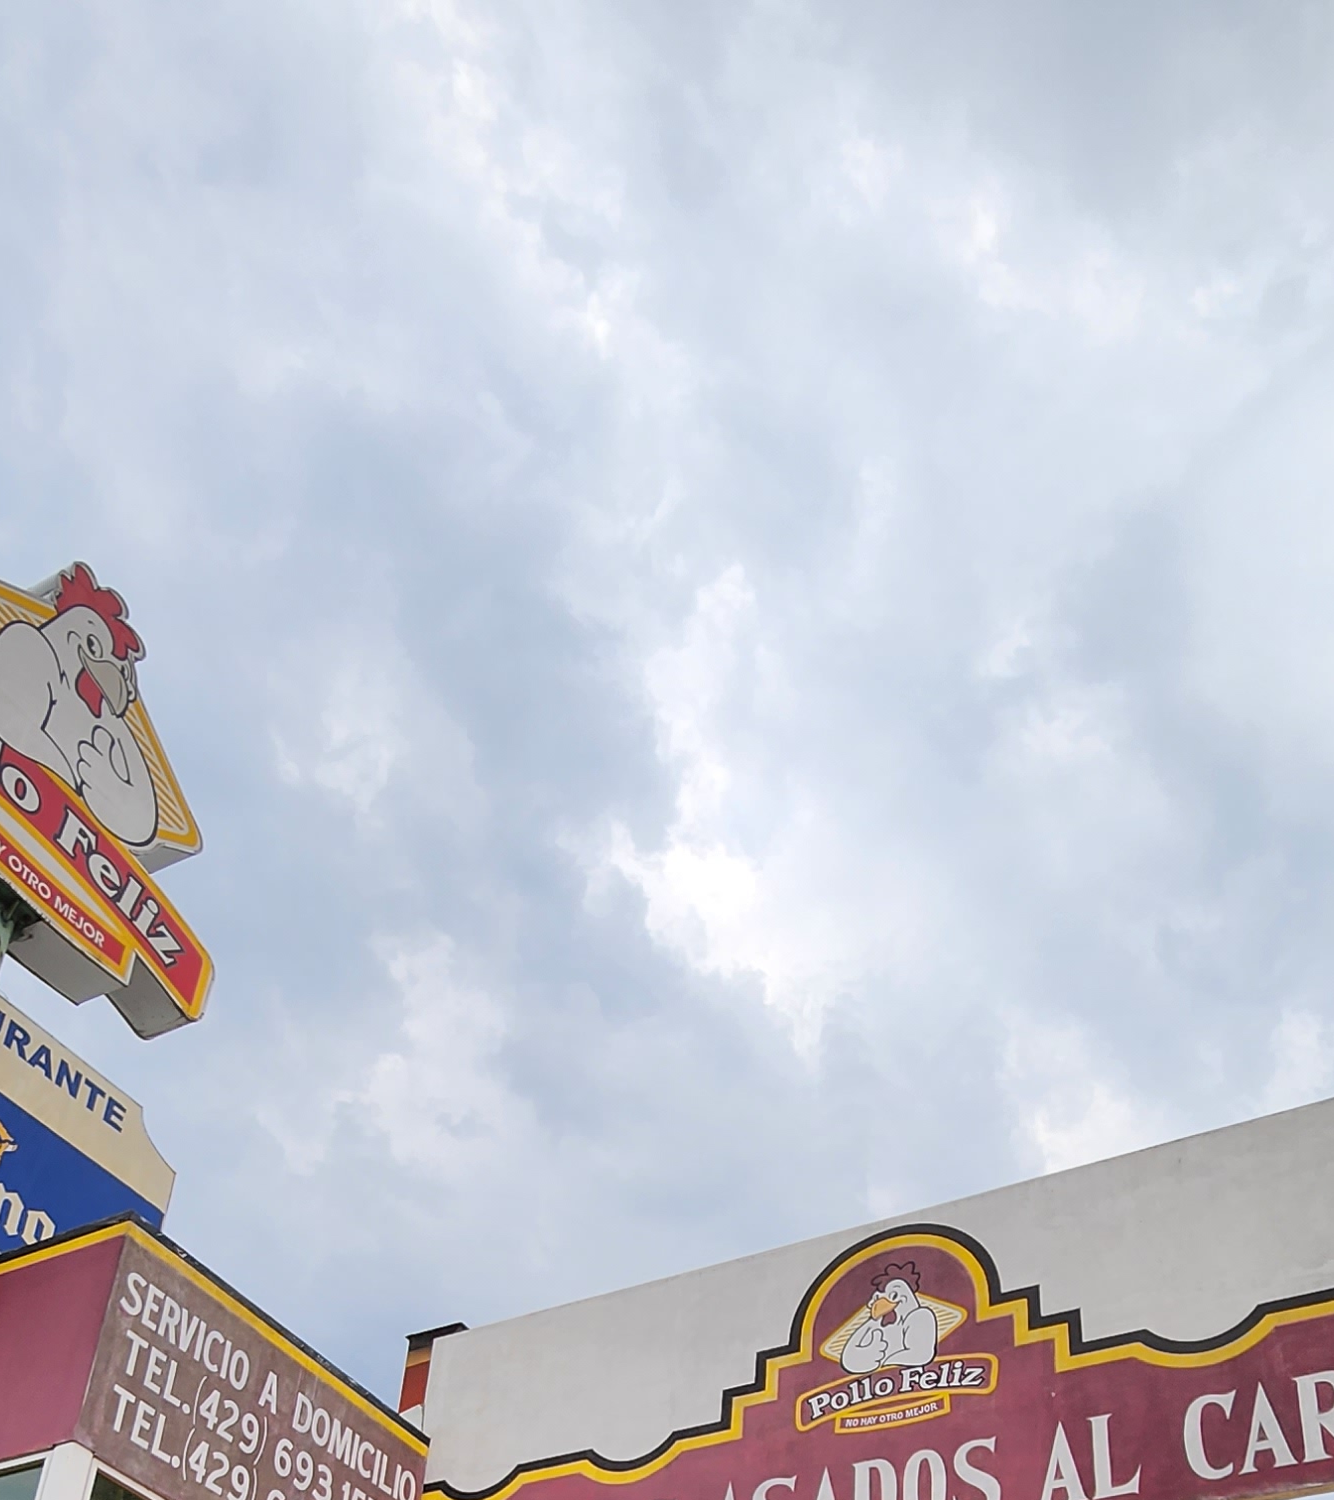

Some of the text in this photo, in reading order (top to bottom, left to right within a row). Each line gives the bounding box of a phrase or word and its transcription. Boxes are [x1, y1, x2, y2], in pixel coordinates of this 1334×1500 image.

[8, 855, 52, 900] OTRO
[54, 896, 106, 949] MEJOR
[54, 804, 186, 966] Feliz
[120, 1272, 250, 1391] SERVICIO
[258, 1371, 279, 1414] A
[808, 1361, 985, 1419] Pollo Feliz
[845, 1402, 938, 1428] NO HAY OTRO MEJOR
